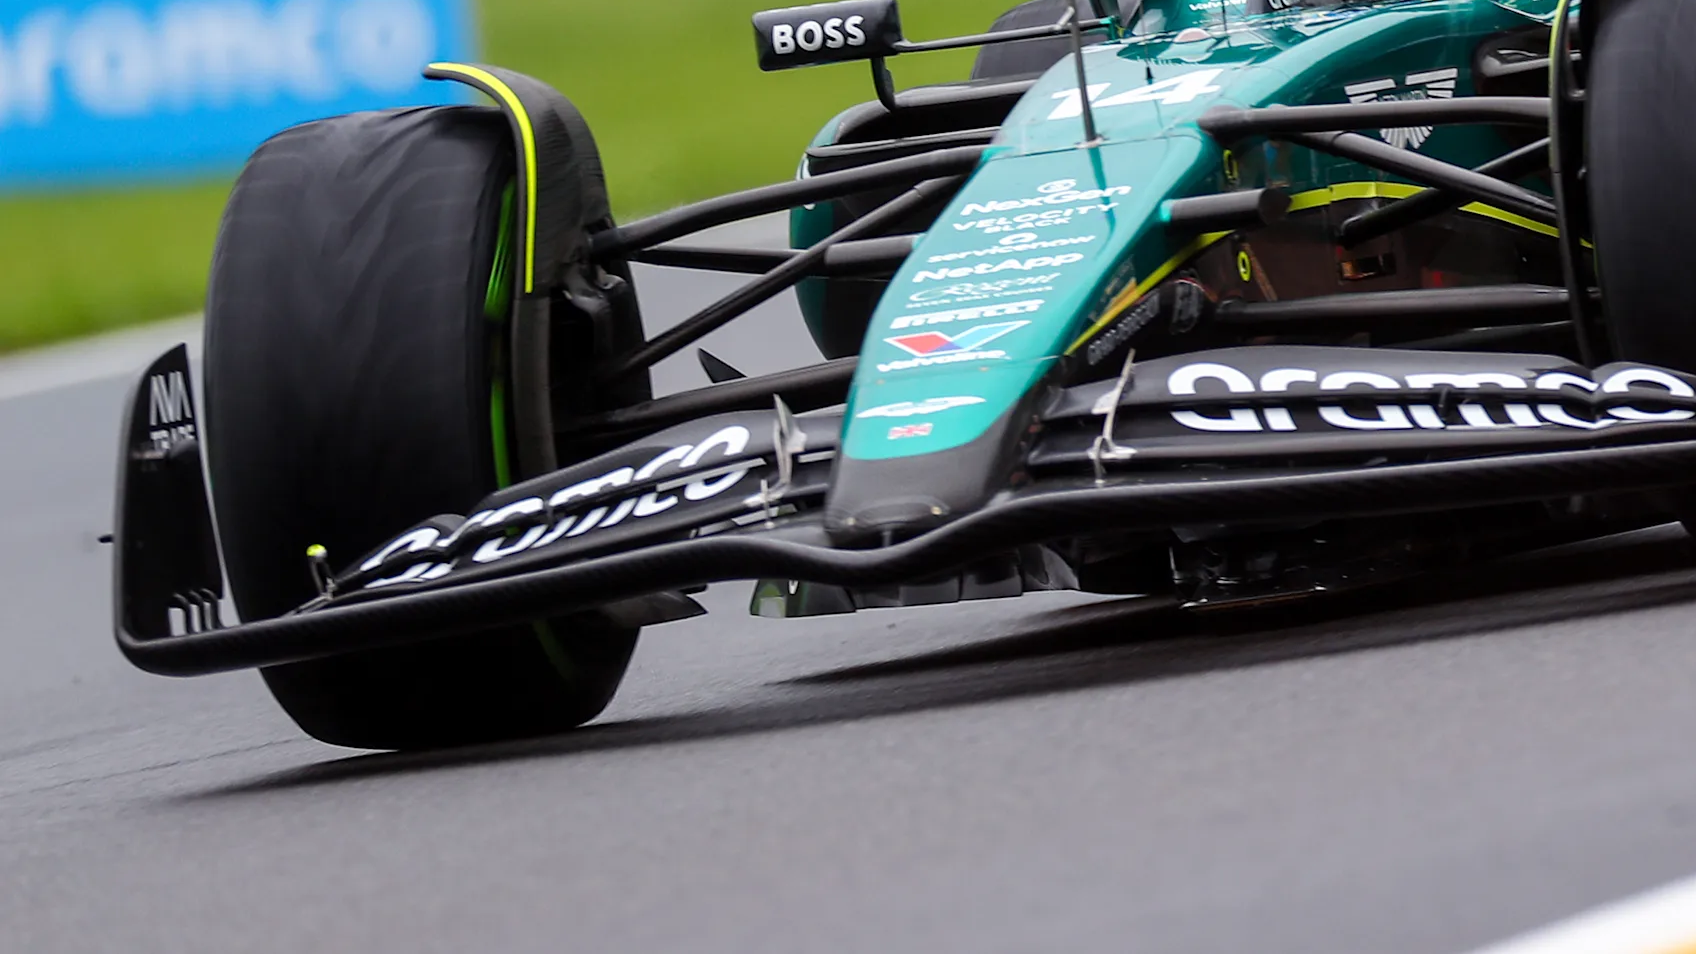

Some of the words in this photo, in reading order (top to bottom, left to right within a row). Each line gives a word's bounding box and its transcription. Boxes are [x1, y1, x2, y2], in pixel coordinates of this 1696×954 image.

[772, 15, 866, 55] BOSS
[1047, 68, 1224, 120] 14
[960, 185, 1132, 216] NexGen
[953, 202, 1119, 231] VELOCITY
[912, 252, 1084, 283] NetApp
[889, 299, 1046, 329] PIRELLI
[1167, 362, 1696, 432] aramco
